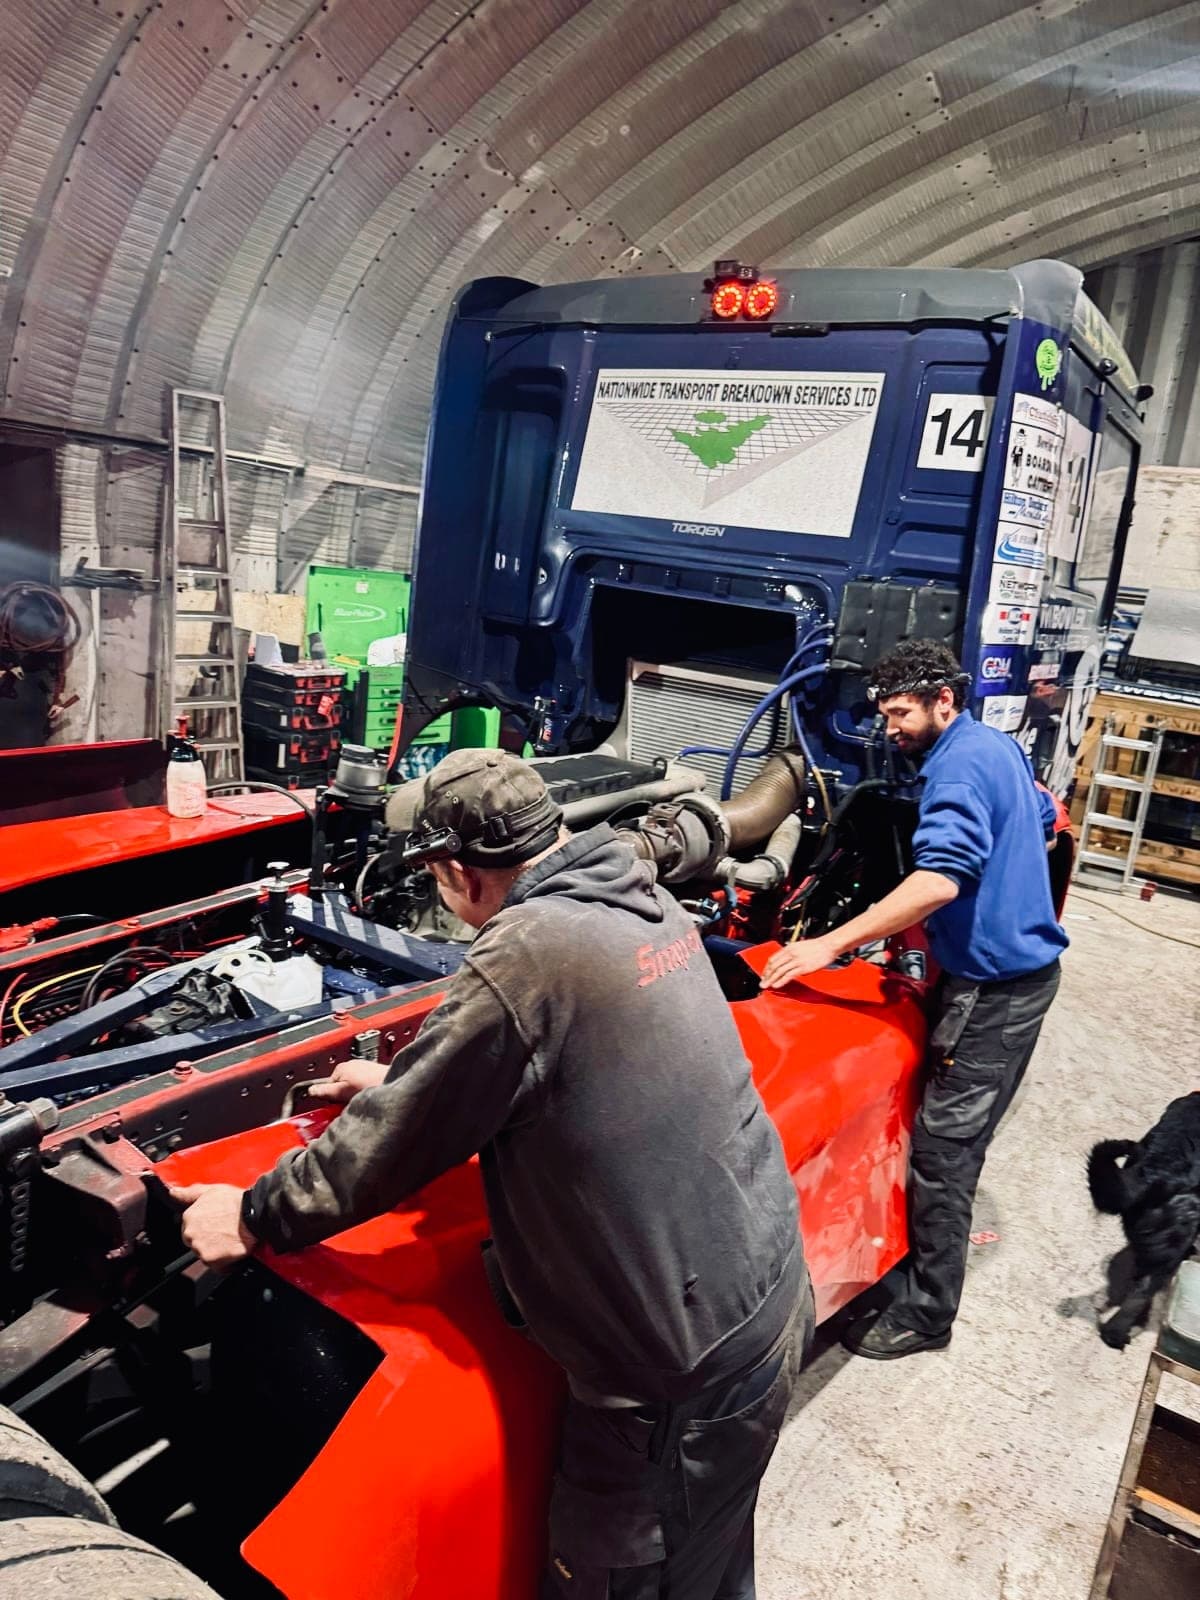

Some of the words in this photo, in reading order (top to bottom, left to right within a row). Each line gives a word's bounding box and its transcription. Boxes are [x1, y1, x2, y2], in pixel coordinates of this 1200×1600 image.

[597, 381, 656, 399] NATIONWIDE
[658, 382, 720, 401] TRANSPORT
[721, 383, 793, 404] BREAKDOWN
[794, 385, 852, 406] SERVICES
[854, 387, 877, 407] LTD
[930, 407, 985, 458] 14
[671, 522, 726, 537] TORQEN
